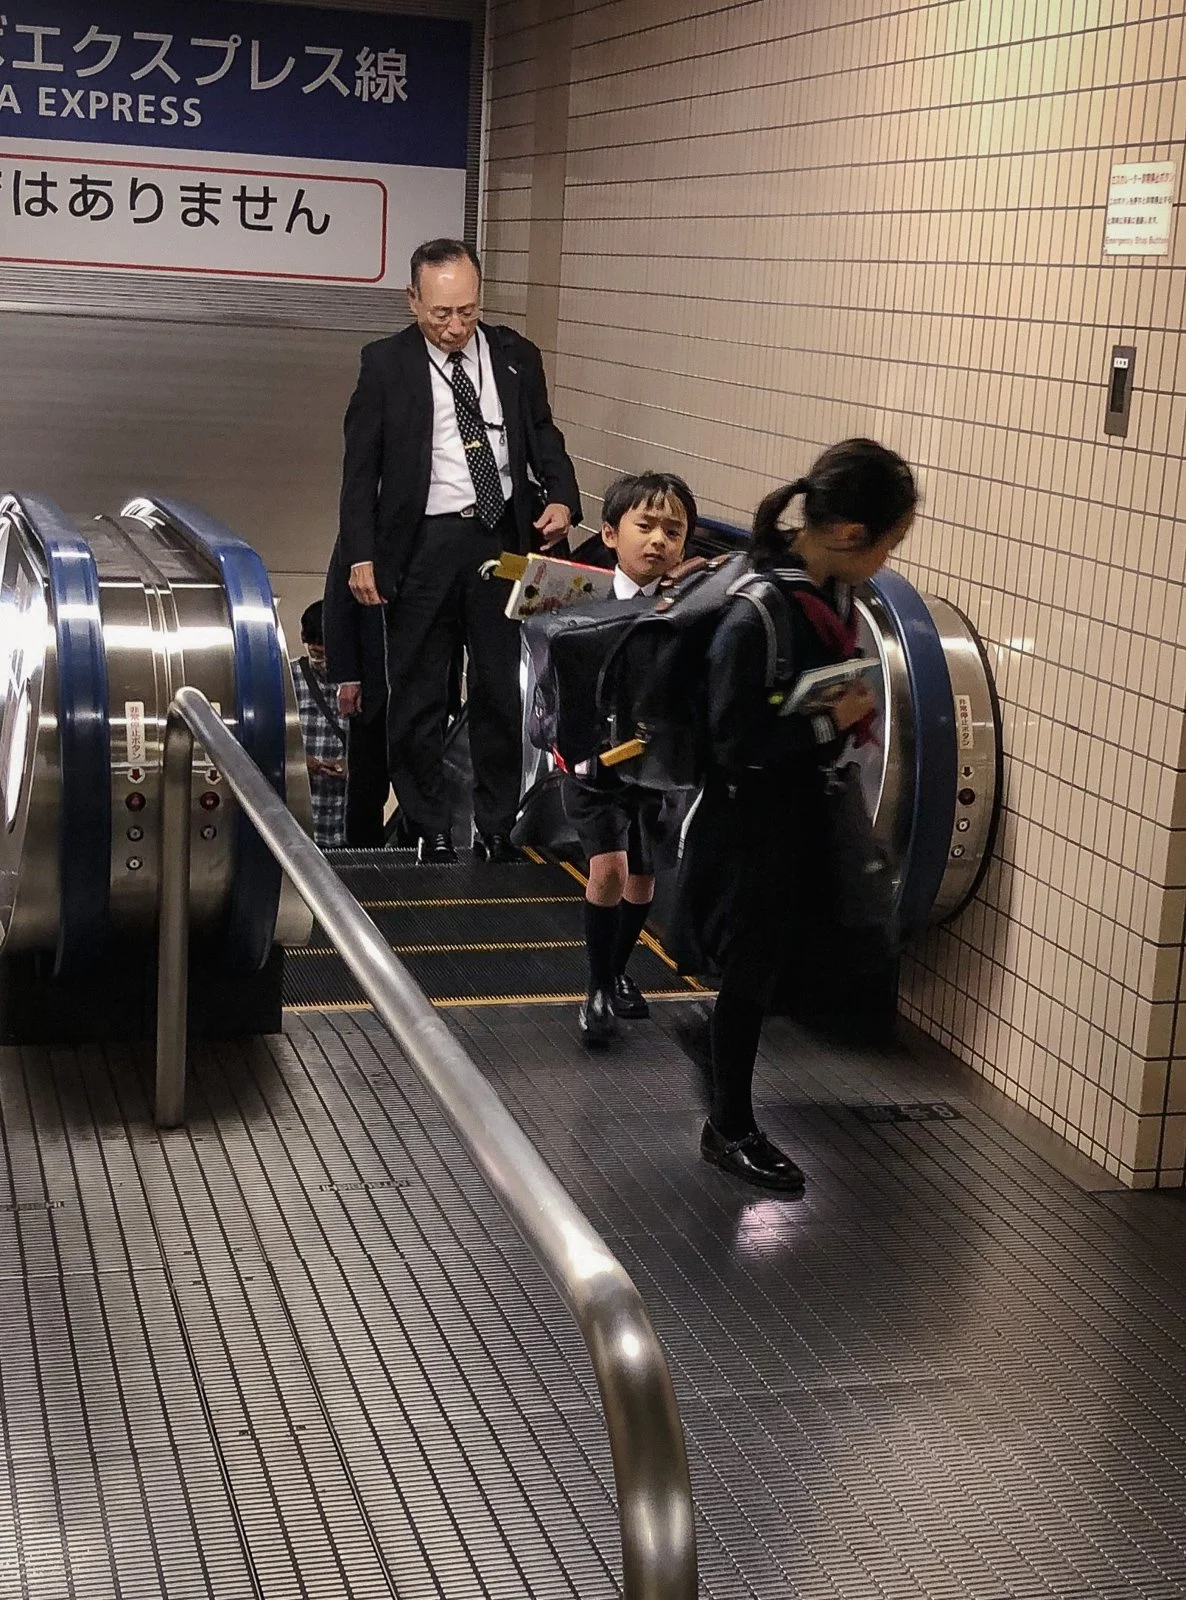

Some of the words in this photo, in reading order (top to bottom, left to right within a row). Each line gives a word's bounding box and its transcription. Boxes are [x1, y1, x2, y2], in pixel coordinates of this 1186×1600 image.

[0, 15, 408, 104] エクスプレス線
[38, 86, 202, 127] EXPRESS
[0, 169, 331, 235] はありません
